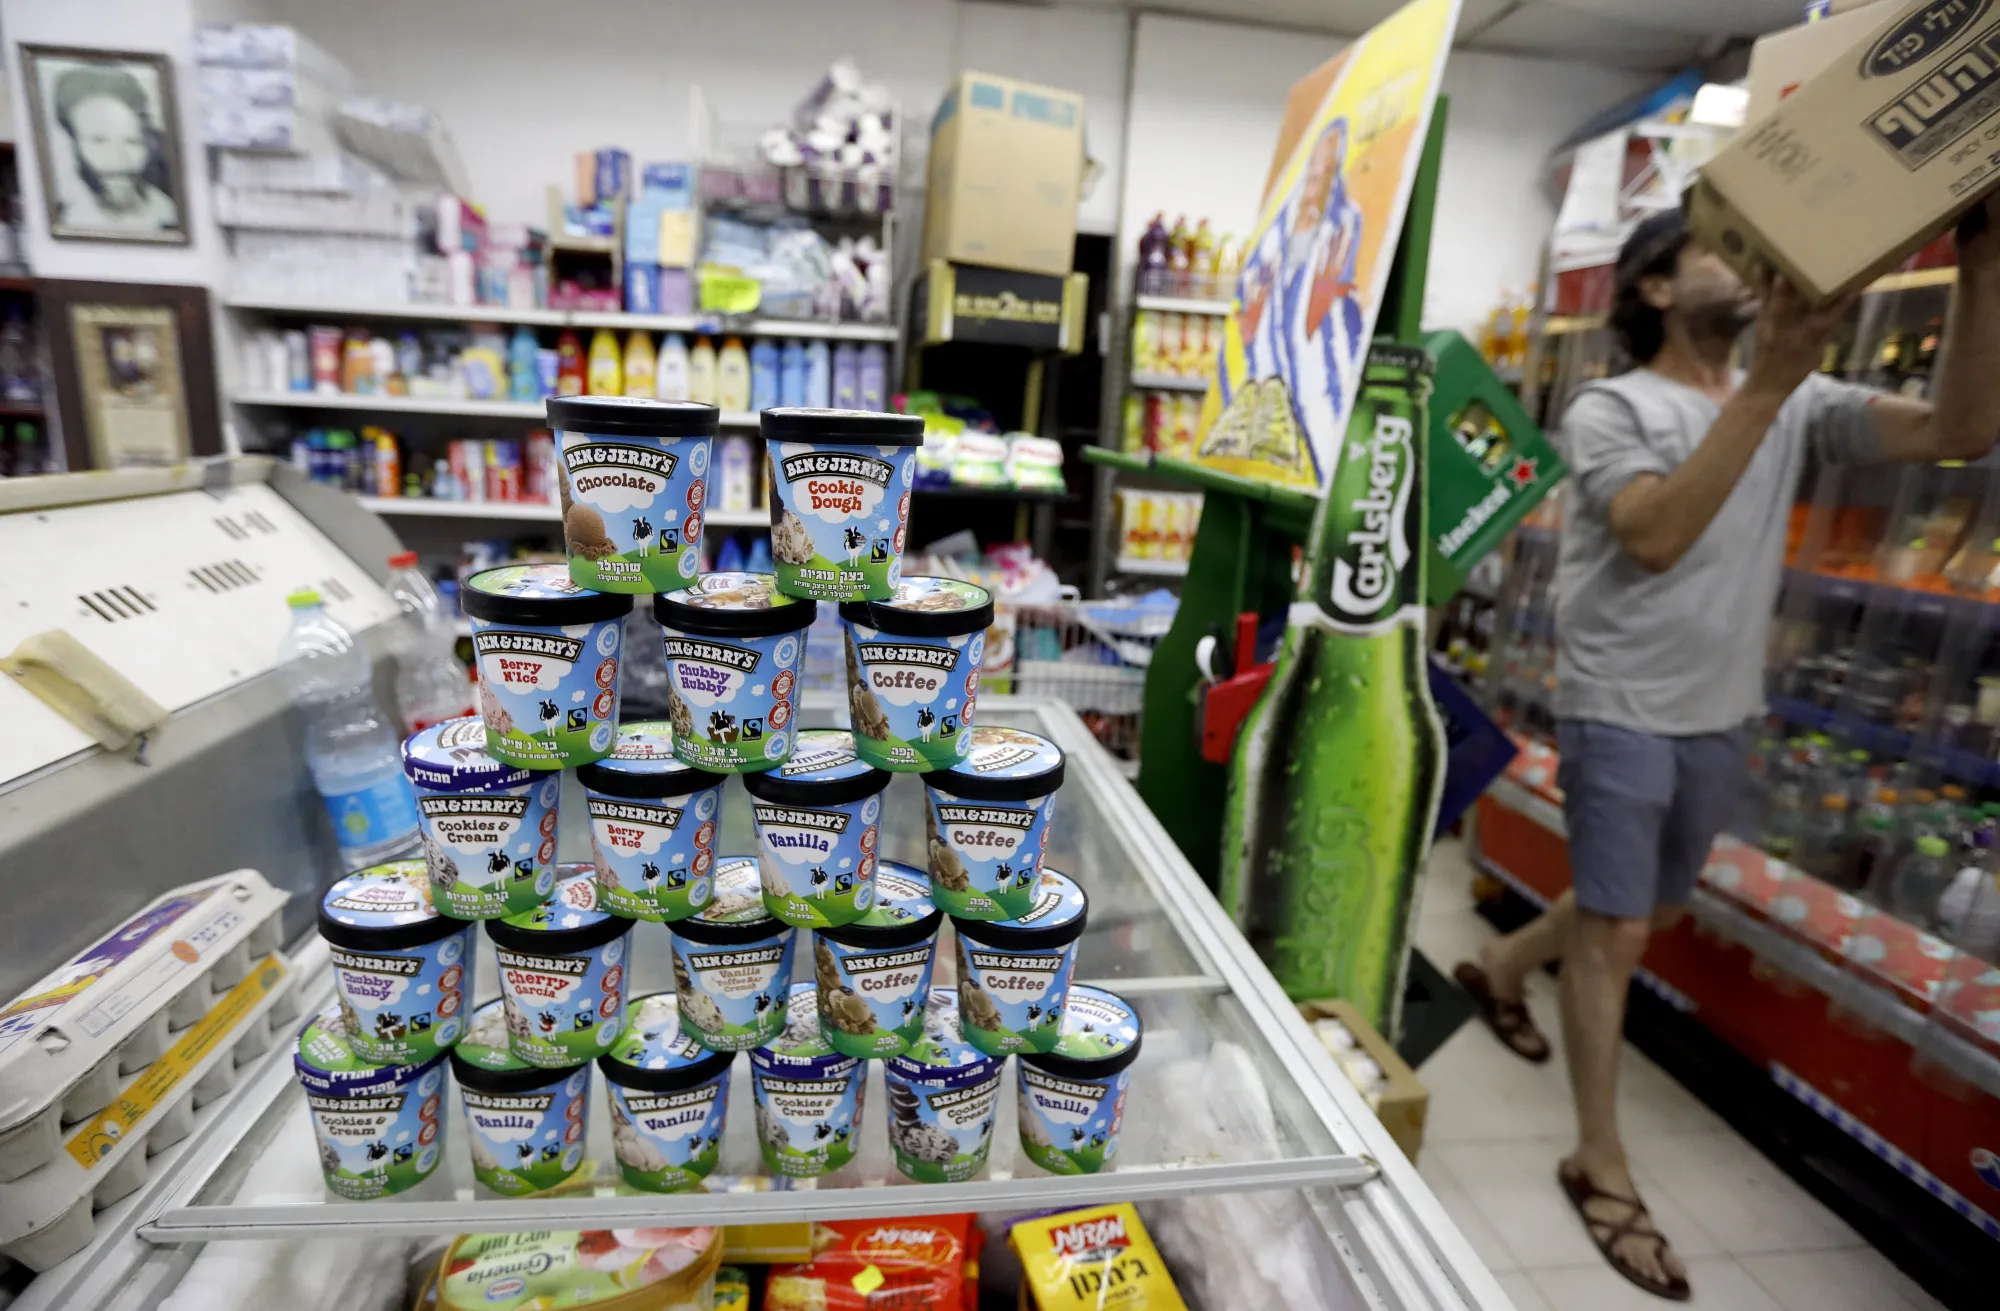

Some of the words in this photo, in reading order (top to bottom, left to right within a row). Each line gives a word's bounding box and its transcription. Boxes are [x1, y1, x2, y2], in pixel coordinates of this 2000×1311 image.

[566, 448, 673, 474] BEN&JERRY'S
[785, 457, 890, 483] BEN&JERRY'S
[577, 473, 656, 493] Chocolate
[808, 480, 864, 495] Cookie
[812, 496, 862, 513] Dough
[1331, 414, 1413, 615] Carlsberg
[596, 560, 641, 574] שוקולד
[800, 568, 835, 580] עוגיות
[840, 571, 864, 583] בצק
[477, 634, 579, 658] BEN&JERRY'S
[664, 642, 755, 668] BEN&JERRY'S
[860, 648, 956, 667] BEN&JERRY'S
[499, 658, 543, 675] Berry
[678, 652, 731, 676] Chubby
[503, 671, 539, 684] N'Ice
[680, 666, 728, 688] Hubby
[873, 671, 937, 690] Coffee
[891, 747, 915, 758] קפה
[422, 800, 525, 814] BEN&JERRY'S
[589, 802, 678, 825] BEN&JERRY'S
[756, 808, 845, 829] BEN&JERRY'S
[940, 808, 1032, 826] BEN&JERRY'S
[437, 820, 495, 832] Cookies
[498, 820, 510, 831] &
[607, 824, 645, 840] Berry
[447, 833, 499, 843] Cream
[610, 836, 641, 849] N'Ice
[768, 833, 829, 852] Vanilla
[954, 831, 1015, 848] Coffee
[692, 948, 783, 968] BEN&JERRY'S
[846, 948, 930, 971] BEN&JERRY'S
[974, 955, 1061, 970] BEN&JERRY'S
[343, 972, 394, 990] Chubby
[507, 970, 569, 991] Cherry
[719, 966, 760, 979] Vanilla
[862, 973, 918, 991] Coffee
[987, 976, 1044, 990] Coffee
[346, 984, 392, 1001] Hubby
[515, 985, 556, 998] Garcia
[1070, 1005, 1112, 1023] Vanilla
[775, 1098, 822, 1107] Cookies
[1035, 1094, 1089, 1116] Vanilla
[321, 1115, 372, 1126] Cookies
[645, 1109, 705, 1131] Vanilla
[782, 1107, 824, 1117] Cream
[475, 1115, 534, 1128] Vanilla
[329, 1125, 376, 1136] Cream
